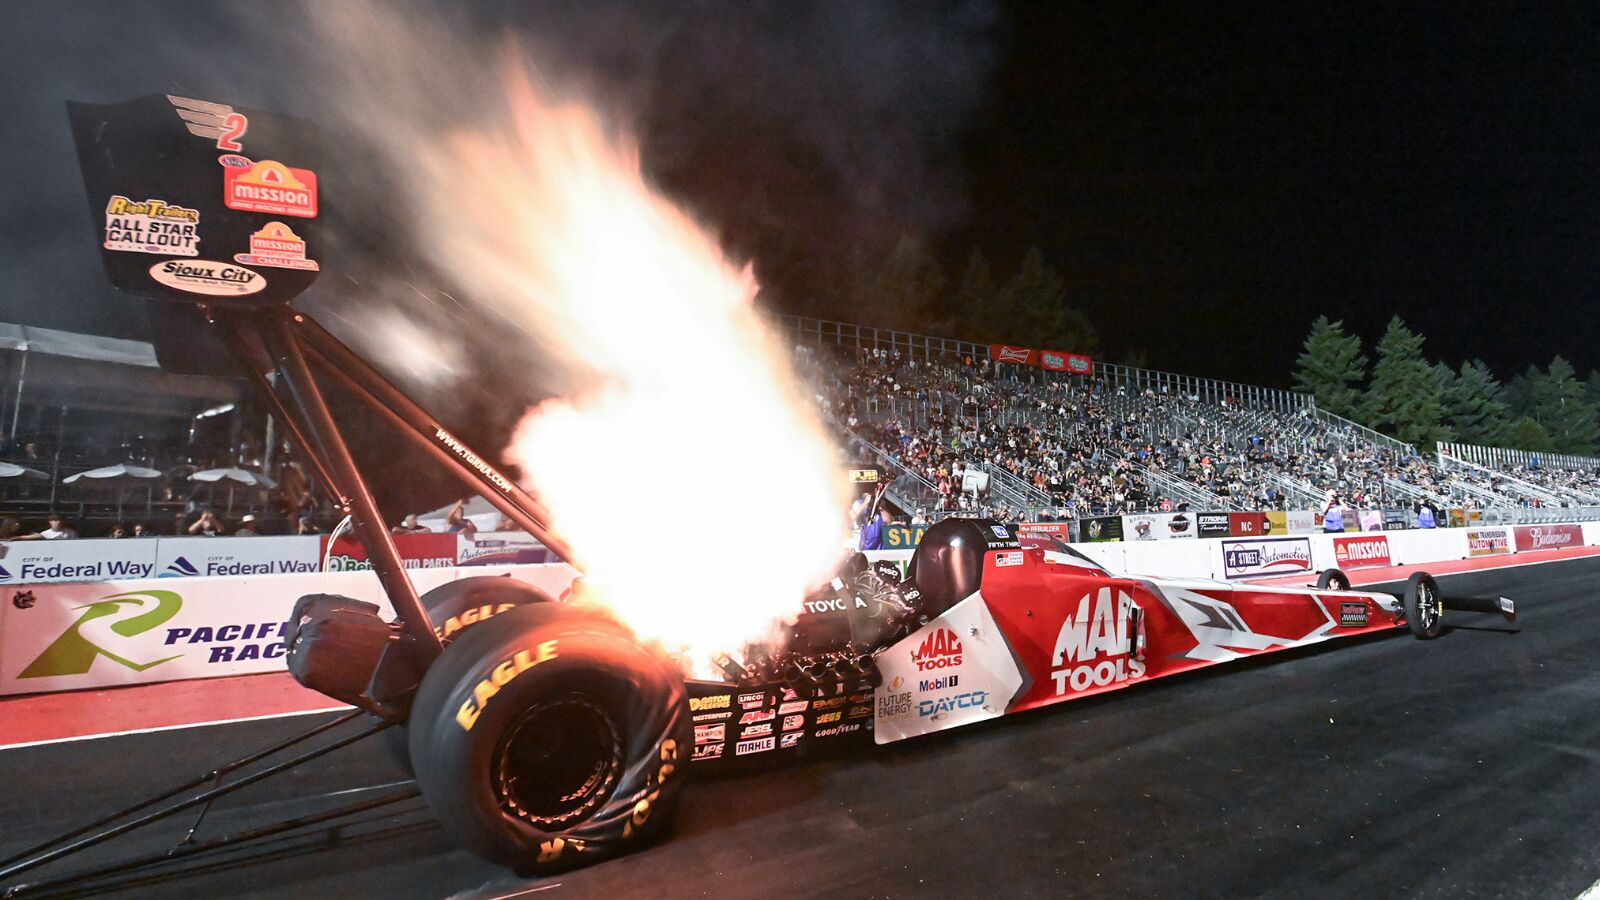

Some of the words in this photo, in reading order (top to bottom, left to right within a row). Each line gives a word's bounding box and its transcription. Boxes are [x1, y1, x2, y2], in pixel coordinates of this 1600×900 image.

[217, 112, 248, 151] 2
[235, 185, 308, 205] MISSION
[109, 218, 143, 231] ALL
[149, 222, 194, 235] STAR
[109, 230, 193, 247] CALLOUT
[254, 239, 302, 252] MISSION
[162, 262, 216, 277] Sioux
[221, 268, 257, 283] City
[435, 428, 512, 492] WWW.TGRNA.COM
[1241, 521, 1253, 532] NC
[888, 528, 926, 546] STA
[1530, 528, 1571, 548] Budweiser
[1229, 553, 1236, 566] A
[1238, 552, 1258, 565] STREET
[1259, 545, 1309, 563] Automotive
[1348, 541, 1389, 559] MISSION
[21, 562, 101, 579] Federal
[107, 560, 154, 578] Way
[207, 560, 275, 576] Federal
[279, 561, 318, 573] Way
[422, 557, 454, 569] PARTS
[879, 566, 899, 577] MSD
[806, 596, 867, 614] TOYOA
[164, 621, 288, 645] PACIFI
[1052, 586, 1147, 667] MAC
[917, 628, 963, 660] MAC
[208, 643, 288, 664] RAC
[917, 656, 963, 672] TOOLS
[455, 639, 560, 732] EAGLE
[919, 676, 948, 692] Mobil
[1051, 658, 1147, 696] TOOLS
[740, 694, 764, 702] LINCO
[878, 692, 911, 707] FUTURE
[915, 690, 988, 717] DAYCO
[878, 703, 912, 718] ENERGY
[696, 730, 723, 738] HAMPION
[740, 723, 774, 736] JESEL
[737, 739, 772, 753] MAHLE
